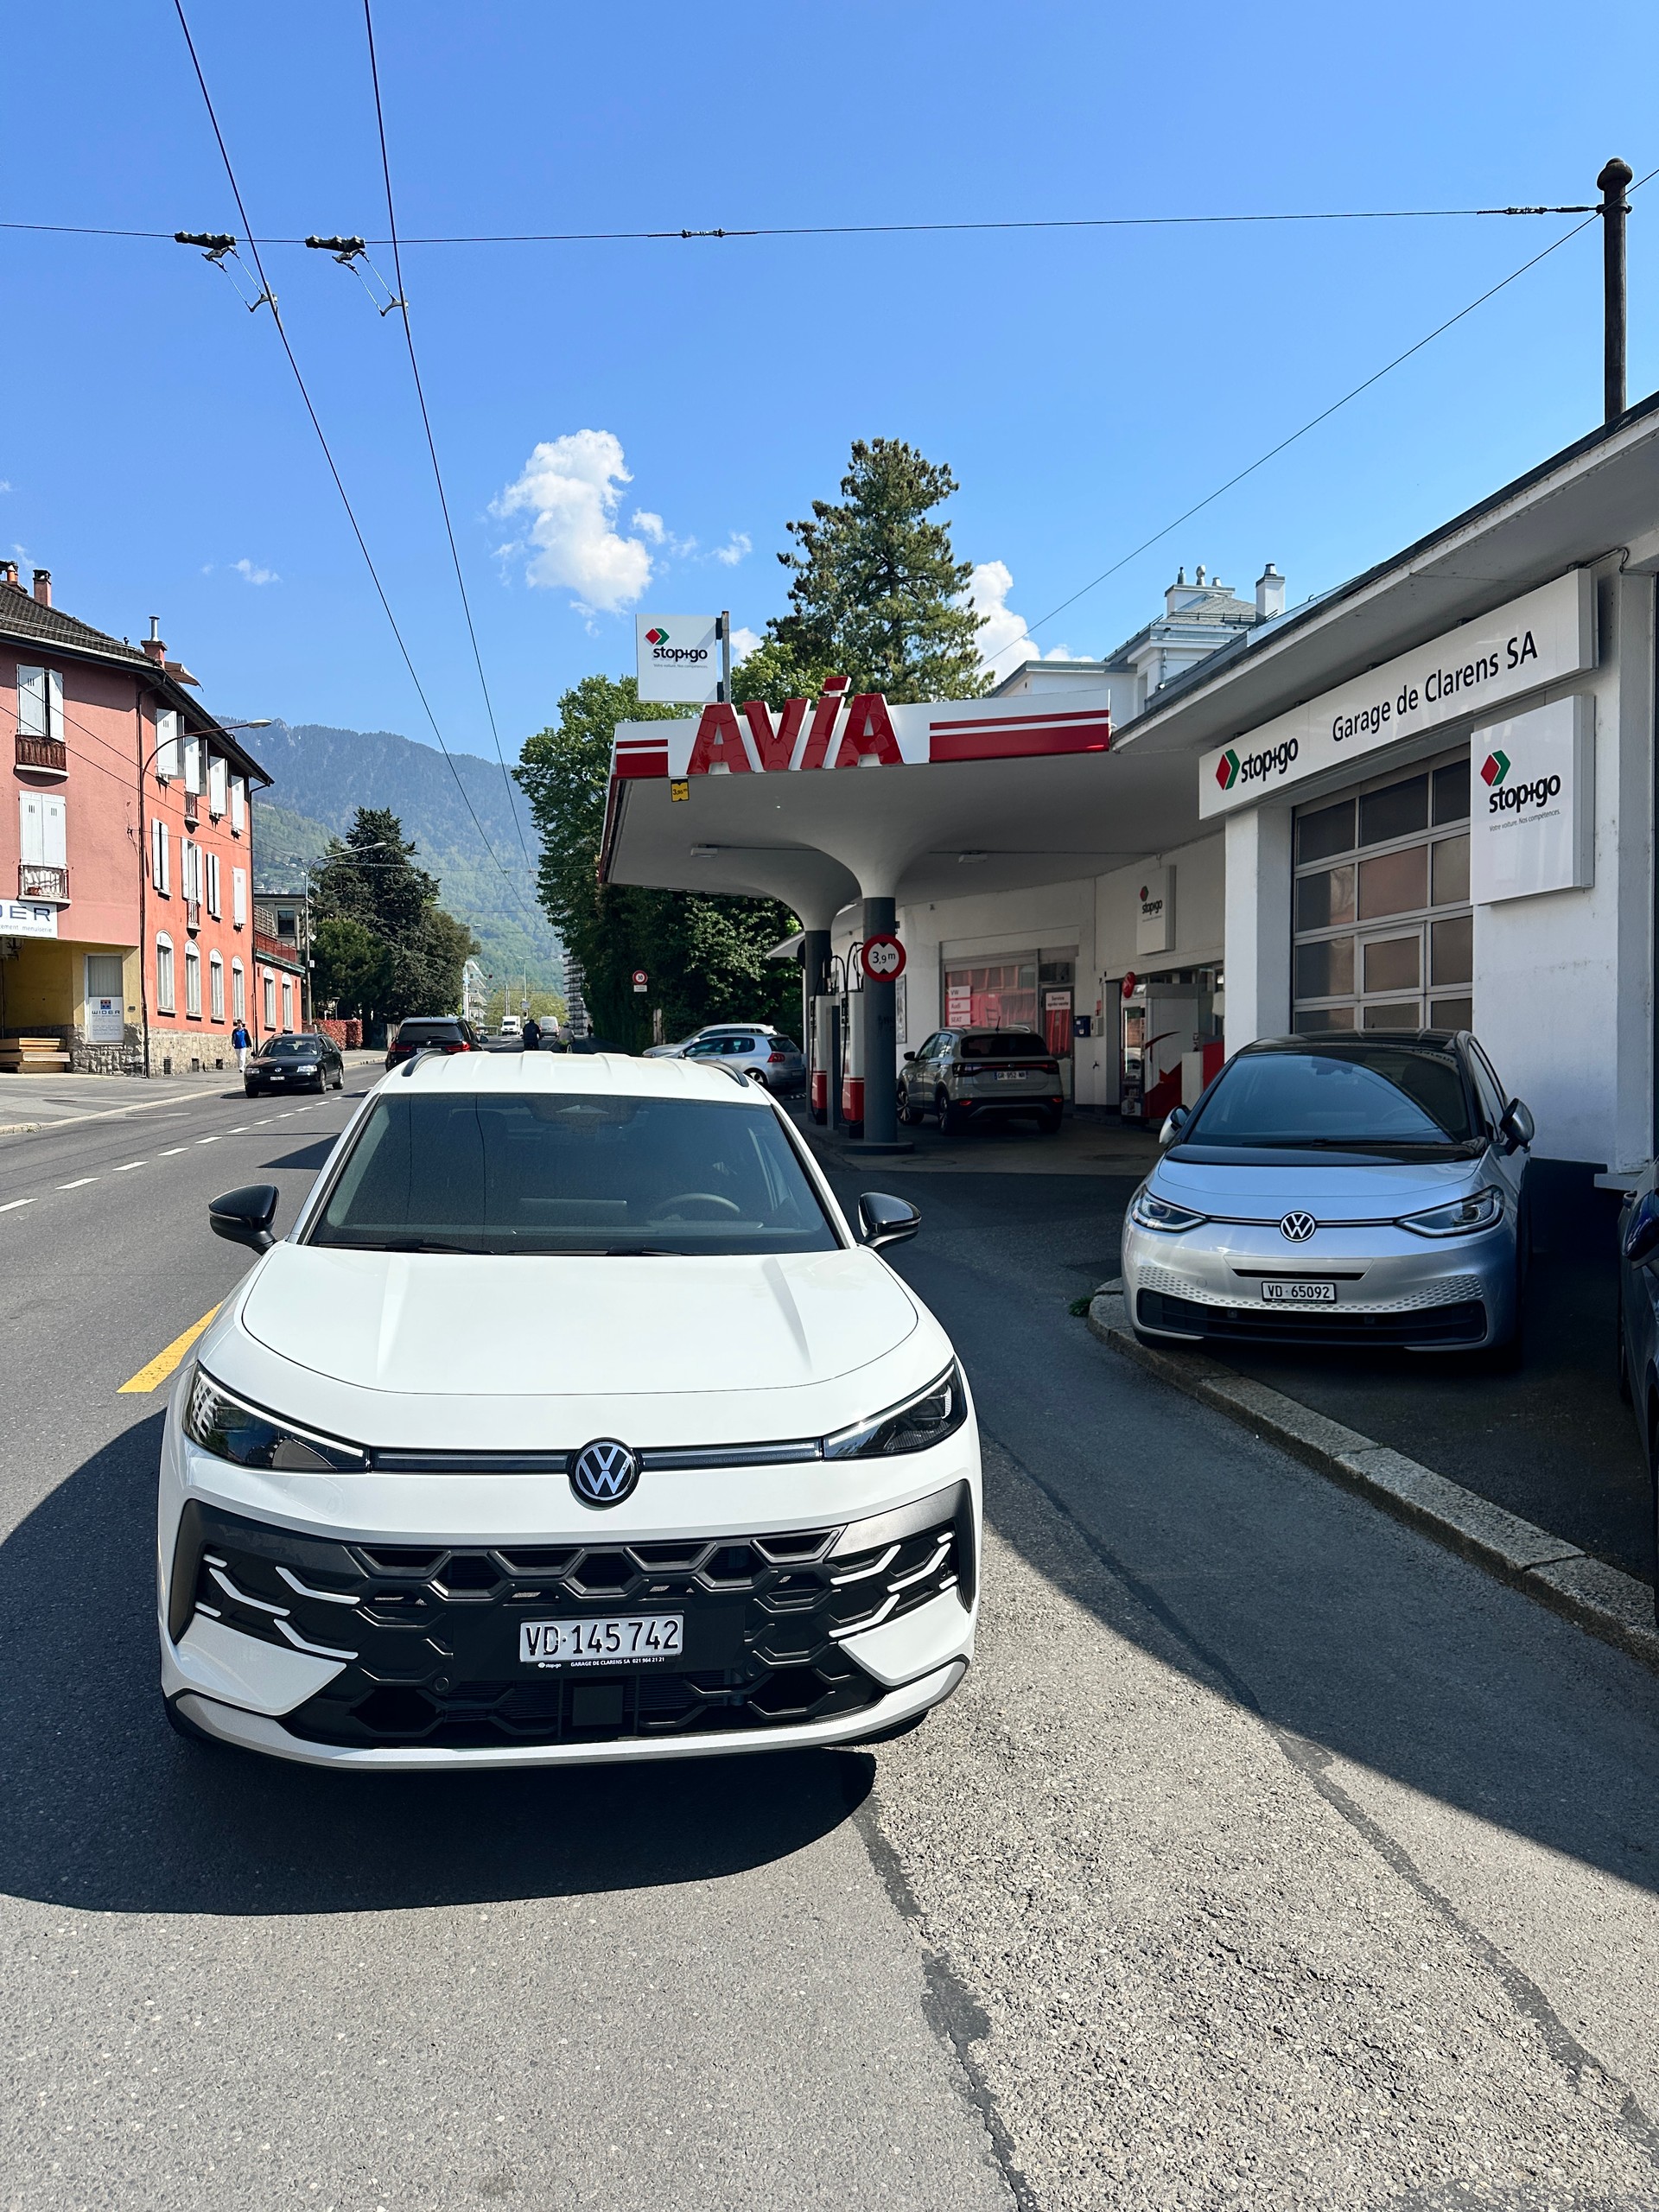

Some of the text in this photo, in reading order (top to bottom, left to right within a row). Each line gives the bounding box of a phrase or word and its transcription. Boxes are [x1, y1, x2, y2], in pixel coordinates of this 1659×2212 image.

[653, 645, 708, 663] stop+go
[1332, 630, 1538, 741] Garage de Clarens SA
[1241, 737, 1299, 783] stop+go
[1489, 774, 1561, 813] stop+go
[0, 904, 50, 922] ER
